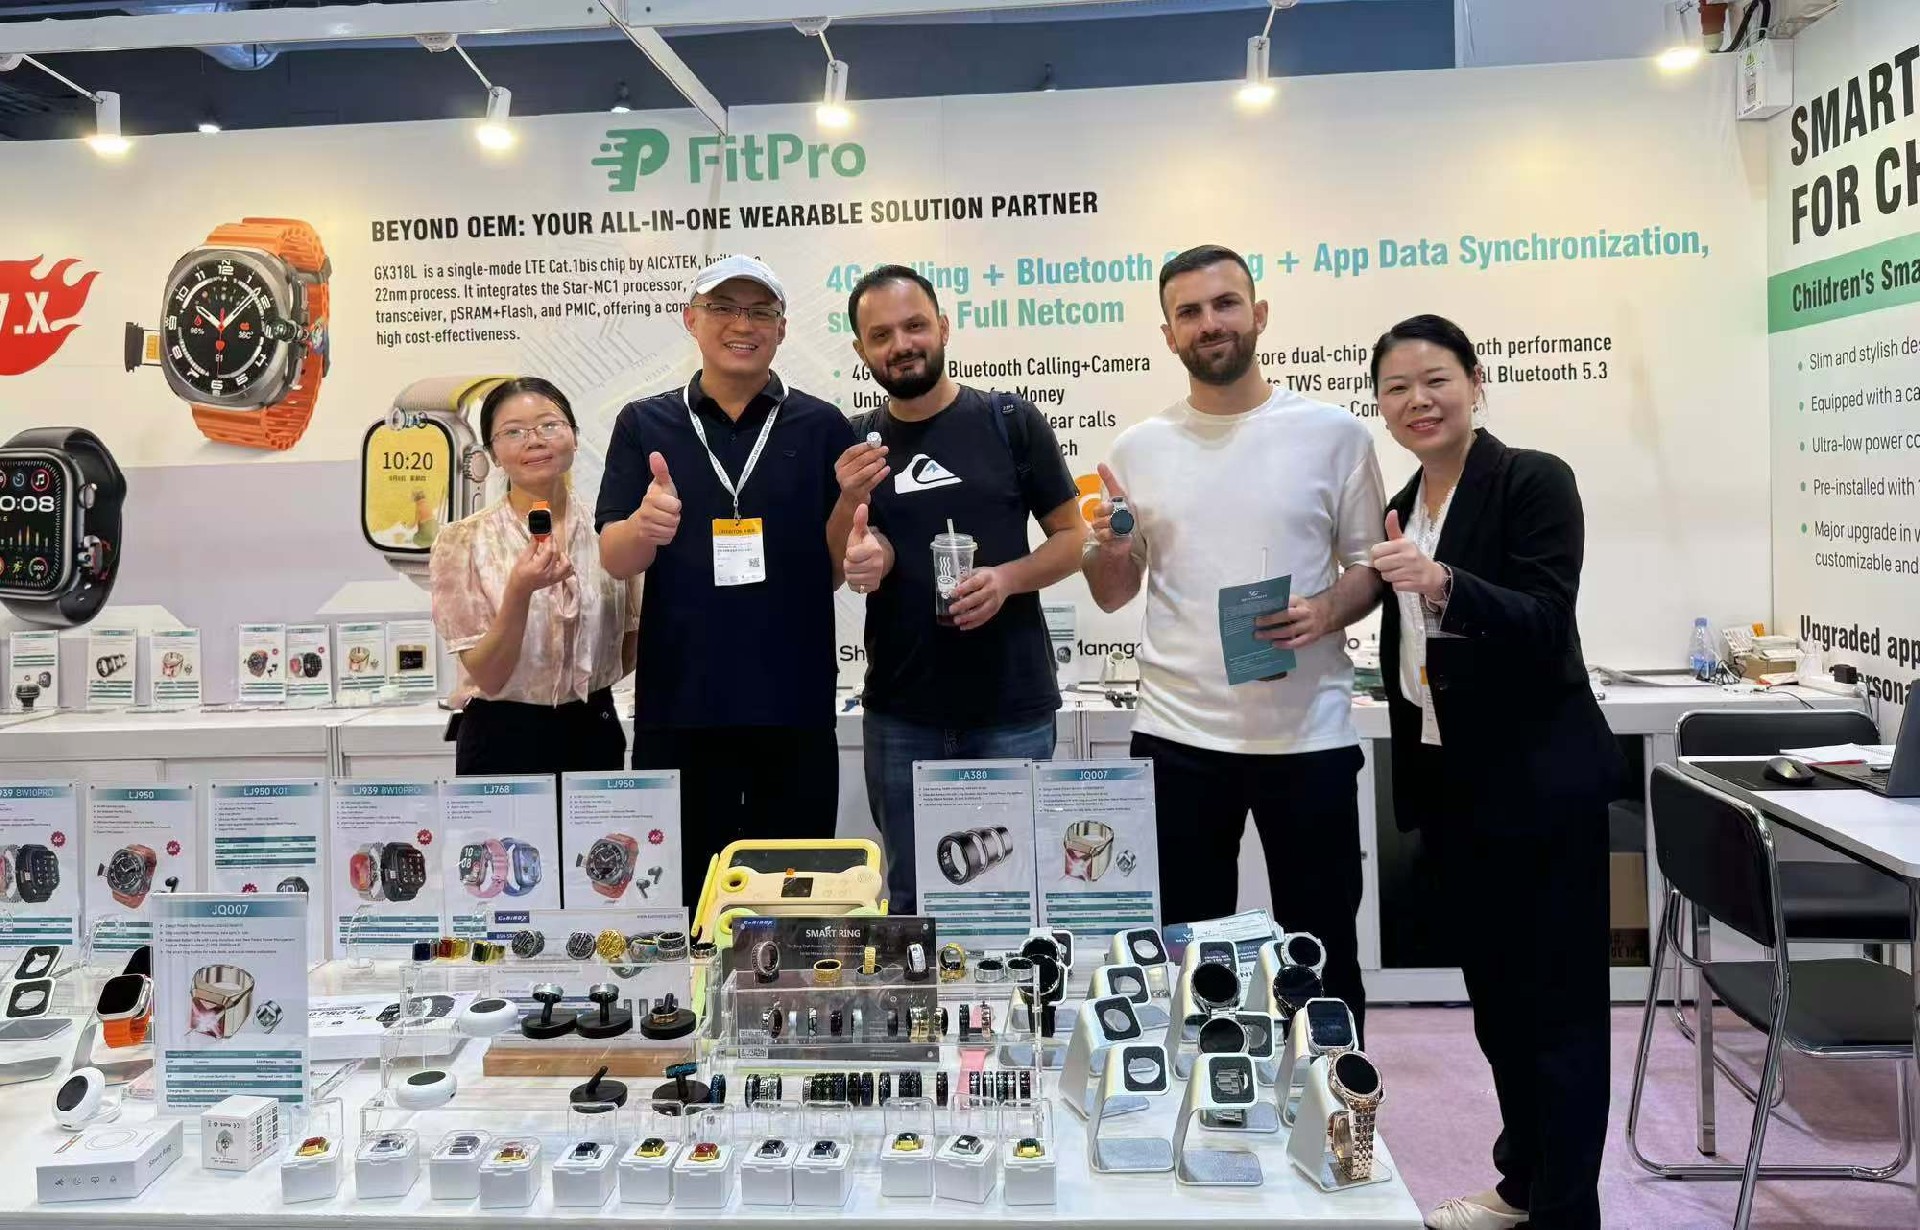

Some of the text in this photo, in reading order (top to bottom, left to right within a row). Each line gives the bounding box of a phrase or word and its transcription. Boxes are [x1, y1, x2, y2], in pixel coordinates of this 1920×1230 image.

[1791, 44, 1920, 167] SMART
[689, 133, 866, 183] FitPro
[1792, 164, 1861, 245] FOR
[372, 191, 1098, 242] BEYOND OEM: YOUR ALL-IN-ONE WEARABLE SOLUTION PARTNER
[1313, 242, 1369, 278] App
[1379, 237, 1449, 269] Data
[1459, 224, 1710, 272] Synchronization,
[375, 264, 417, 281] GX318L
[424, 264, 434, 278] is
[437, 267, 444, 278] a
[448, 261, 522, 280] single-mode
[525, 259, 546, 274] LTE
[601, 257, 625, 274] chip
[630, 256, 643, 273] by
[648, 255, 701, 270] AICXTEK,
[1017, 253, 1153, 286] Bluetooth
[376, 279, 687, 304] 22nm process. It integrates the Star-MC1 processor,
[1793, 268, 1875, 312] Children's
[376, 307, 447, 323] transceiver,
[451, 304, 537, 324] pSRAM+Flash,
[541, 303, 561, 318] and
[565, 302, 600, 317] PMIC,
[603, 301, 651, 317] offering
[655, 303, 661, 314] a
[377, 328, 521, 348] high cost-effectiveness.
[1473, 335, 1612, 358] oth performance
[1292, 344, 1367, 365] dual-chip
[1810, 353, 1832, 370] Slim
[1835, 346, 1856, 366] and
[1859, 339, 1898, 364] stylish
[948, 359, 1022, 379] Bluetooth
[1027, 355, 1151, 379] Calling+Camera
[1498, 363, 1577, 383] Bluetooth
[1583, 362, 1608, 380] 5.3
[1286, 373, 1322, 391] TWS
[1016, 387, 1065, 406] Money
[1811, 388, 1863, 414] Equipped
[1866, 386, 1892, 405] with
[1895, 388, 1902, 403] a
[1079, 410, 1116, 427] calls
[1812, 434, 1862, 453] Ultra-low
[1865, 435, 1903, 455] power
[383, 451, 433, 470] 10:20
[1814, 476, 1915, 496] Pre-installed with
[1815, 520, 1911, 544] Major upgrade in
[1815, 551, 1919, 574] customizable and
[607, 779, 635, 788] LJ950
[1079, 770, 1108, 780] JQ007
[128, 790, 155, 799] LJ950
[243, 787, 270, 796] LJ950
[484, 785, 510, 794] LJ768
[212, 904, 249, 916] JQ007
[806, 928, 861, 938] SMART RING
